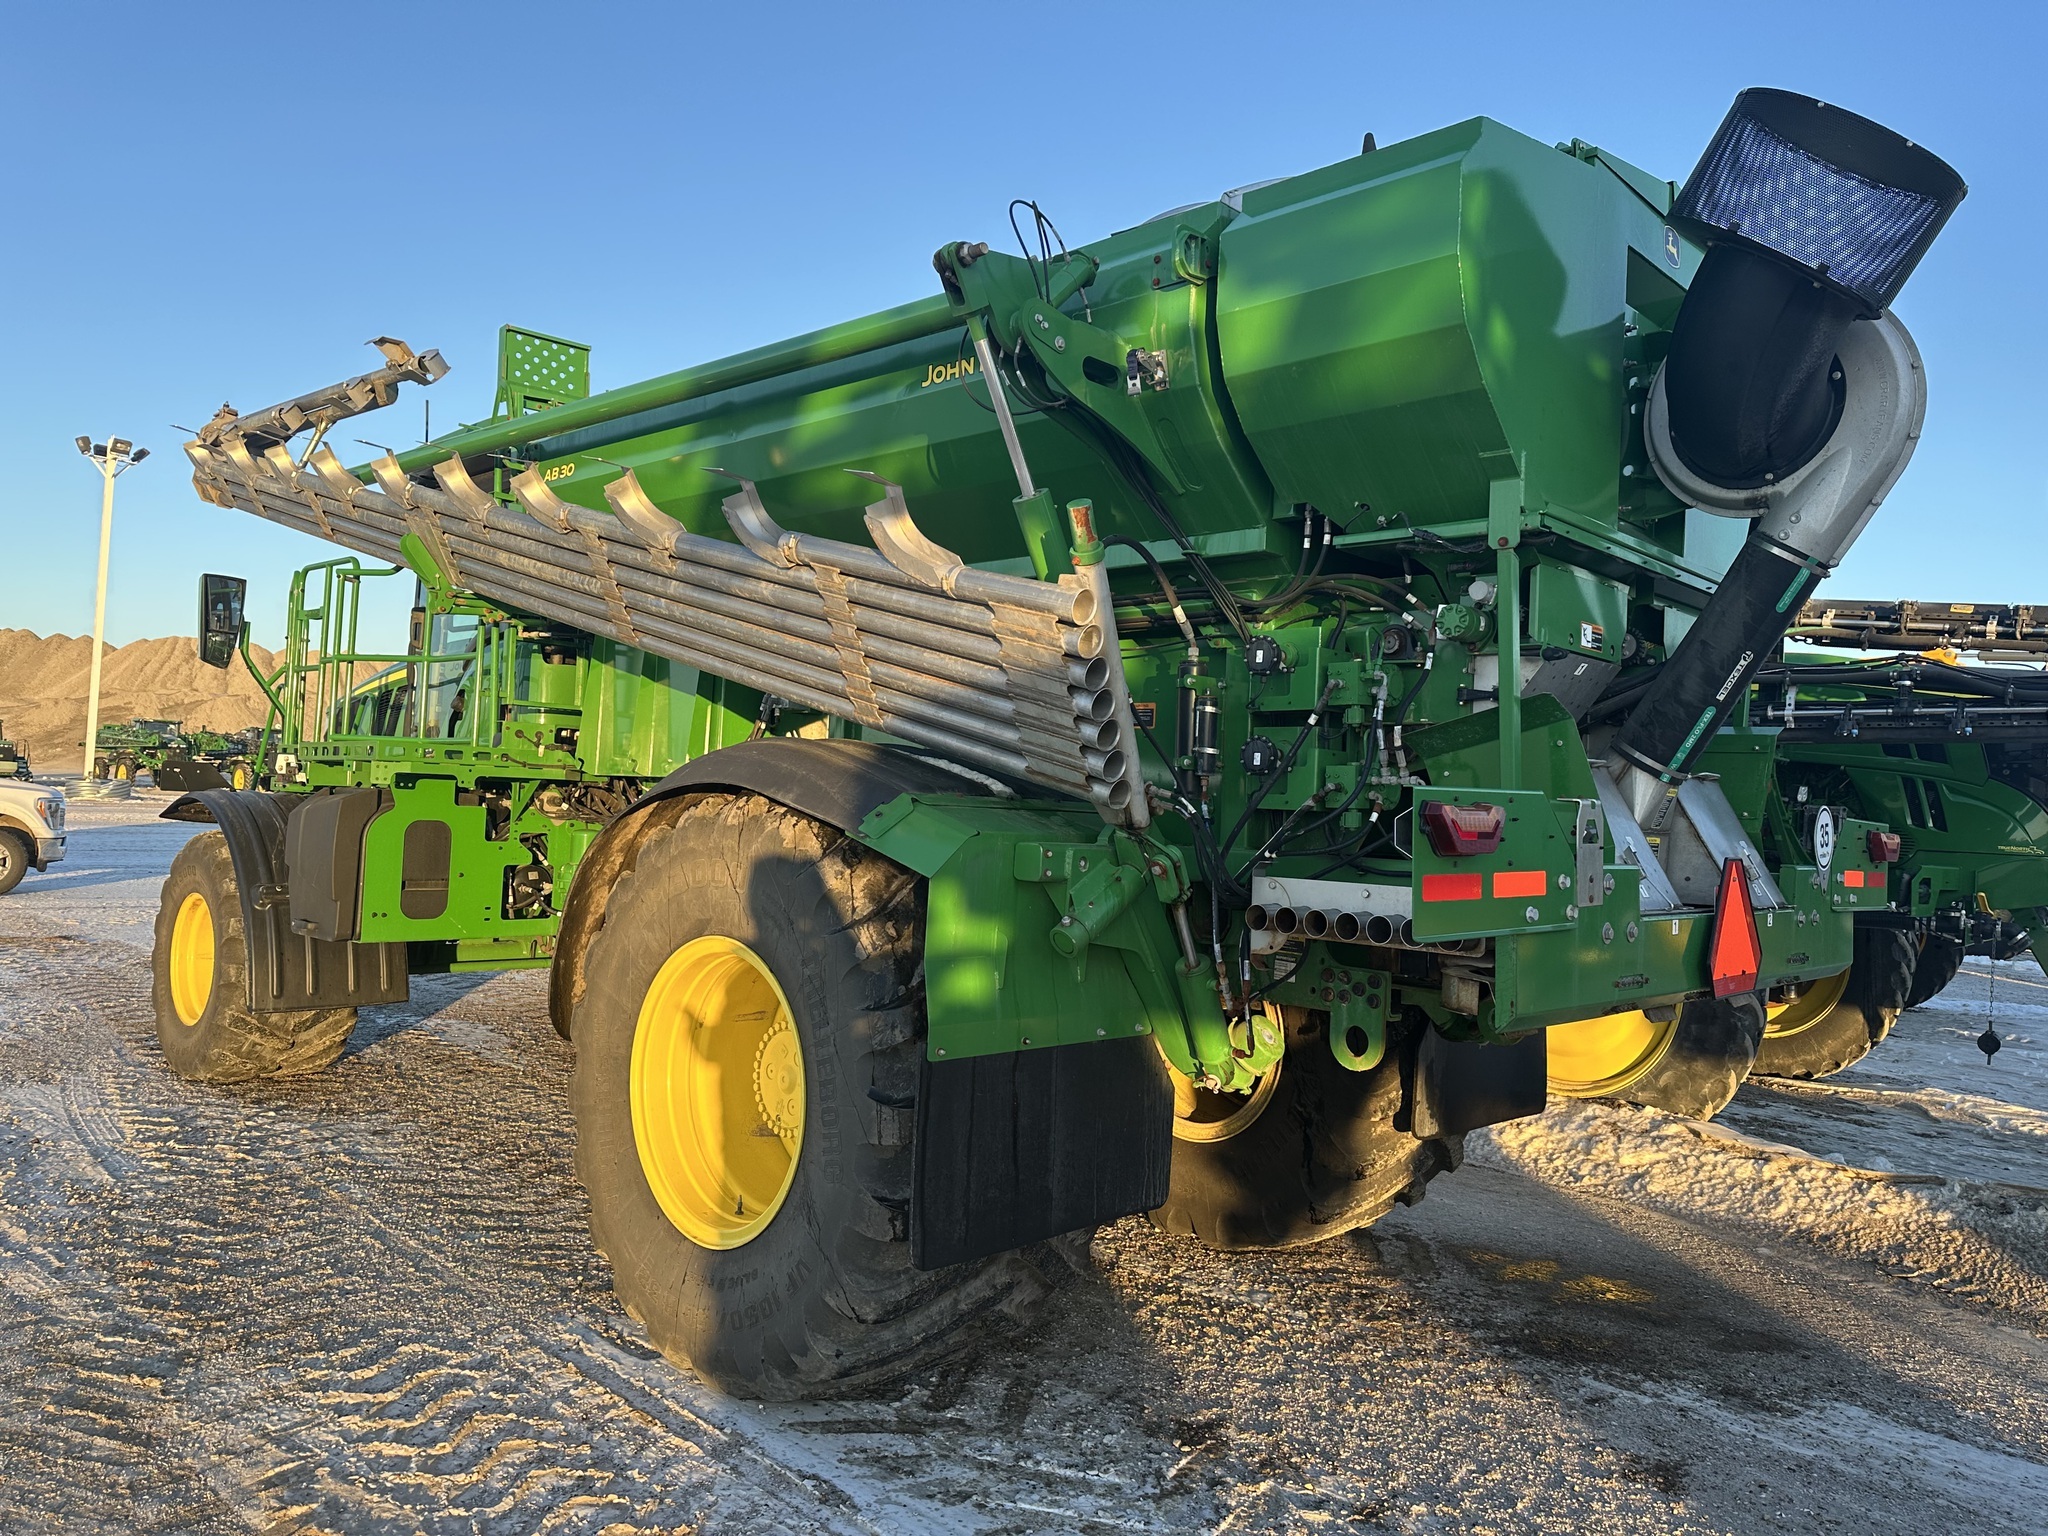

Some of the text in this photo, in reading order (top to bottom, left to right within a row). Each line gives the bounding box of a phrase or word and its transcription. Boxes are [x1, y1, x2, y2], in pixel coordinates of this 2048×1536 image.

[921, 356, 976, 388] JOHN
[1718, 662, 1746, 698] TEXCEL
[1695, 710, 1713, 735] TEX-FLO
[1819, 823, 1830, 849] 35
[802, 949, 844, 1185] TRELLEBORG
[784, 1257, 814, 1300] VF
